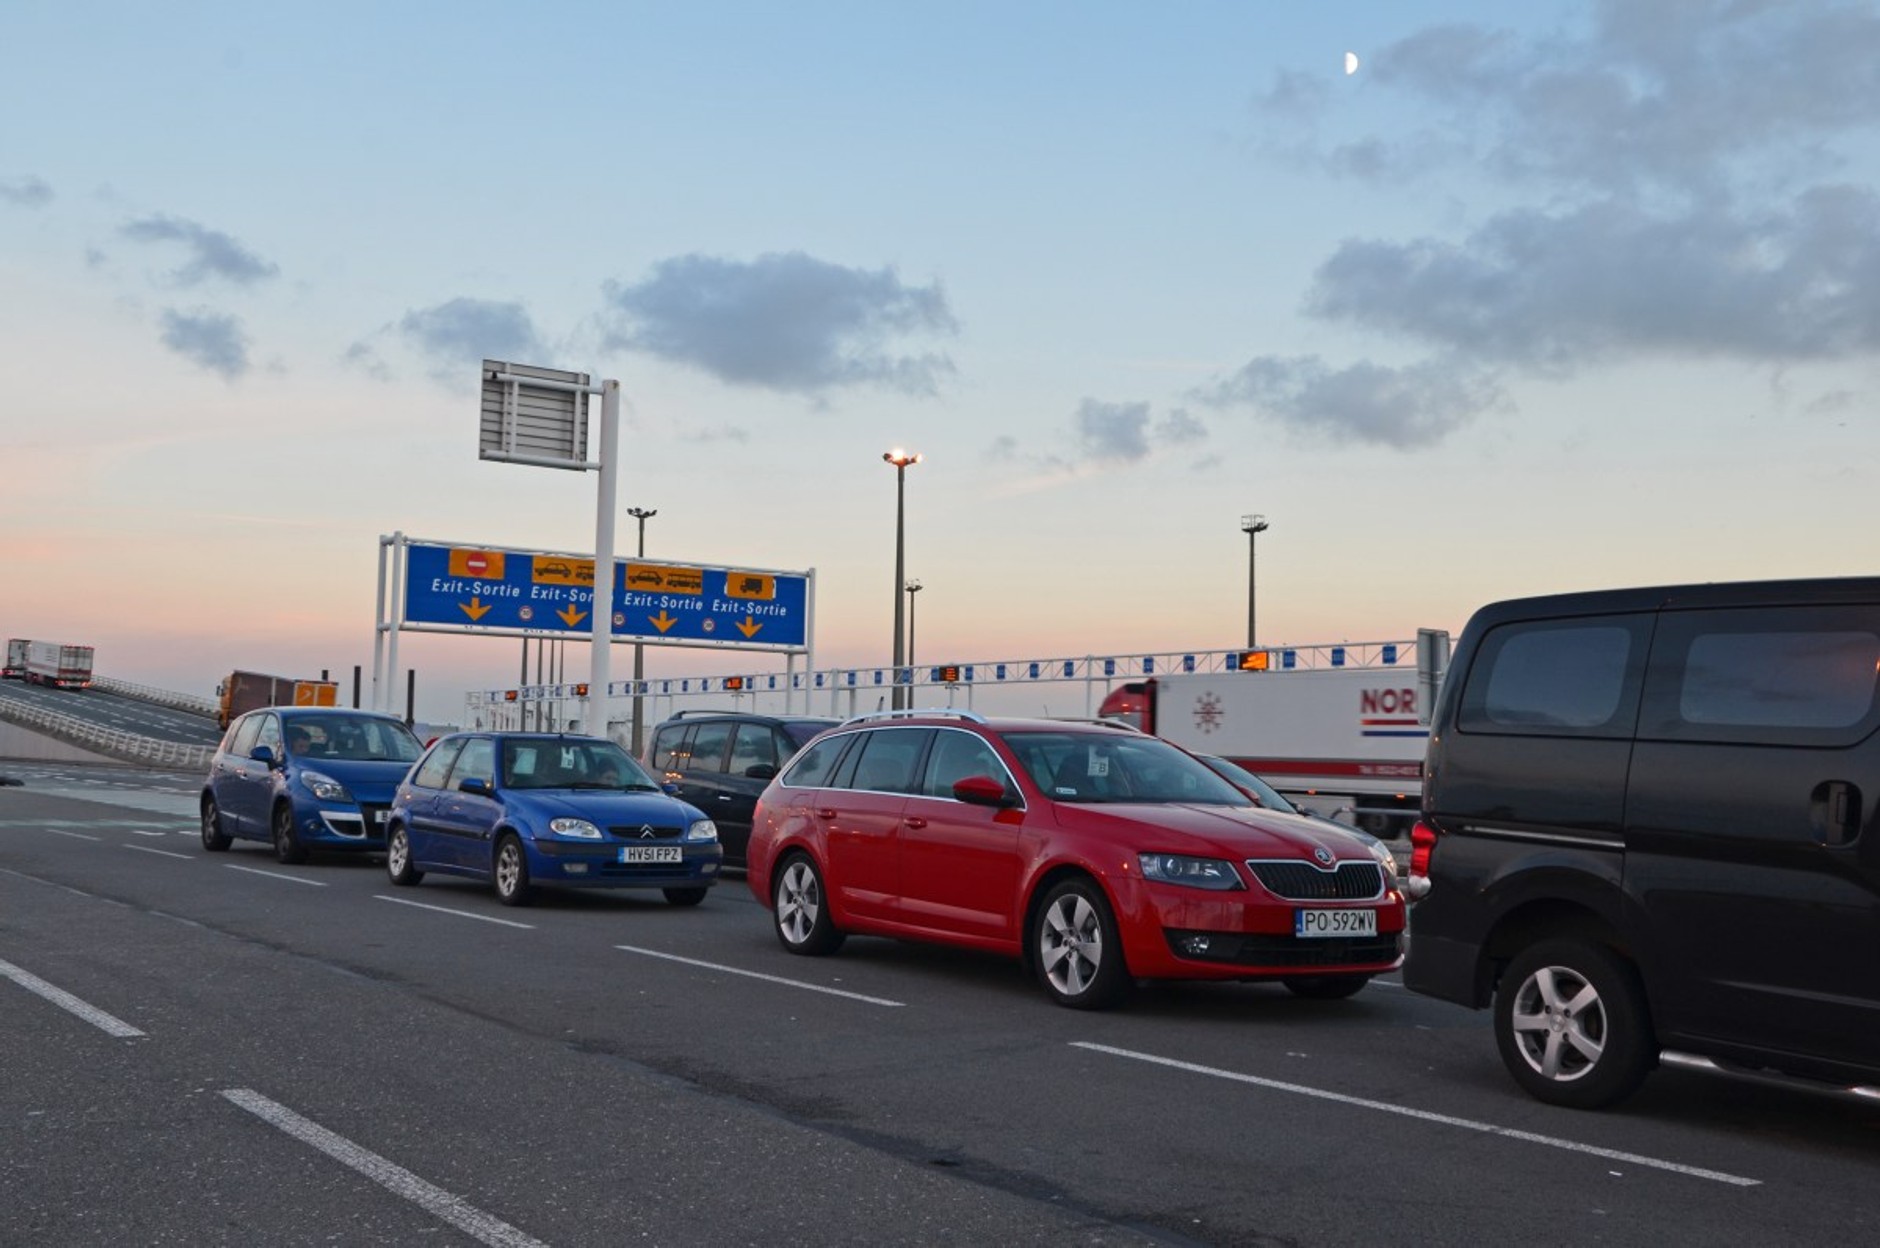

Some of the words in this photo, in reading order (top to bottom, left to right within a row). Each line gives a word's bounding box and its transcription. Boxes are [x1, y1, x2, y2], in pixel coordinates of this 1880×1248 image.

[431, 578, 521, 597] Exit-Sortie
[530, 585, 596, 602] Exit-Sor
[624, 592, 704, 611] Exit-Sortie
[712, 598, 787, 616] Exit-Sortie
[1304, 912, 1328, 931] PO
[1333, 911, 1374, 931] 592WV
